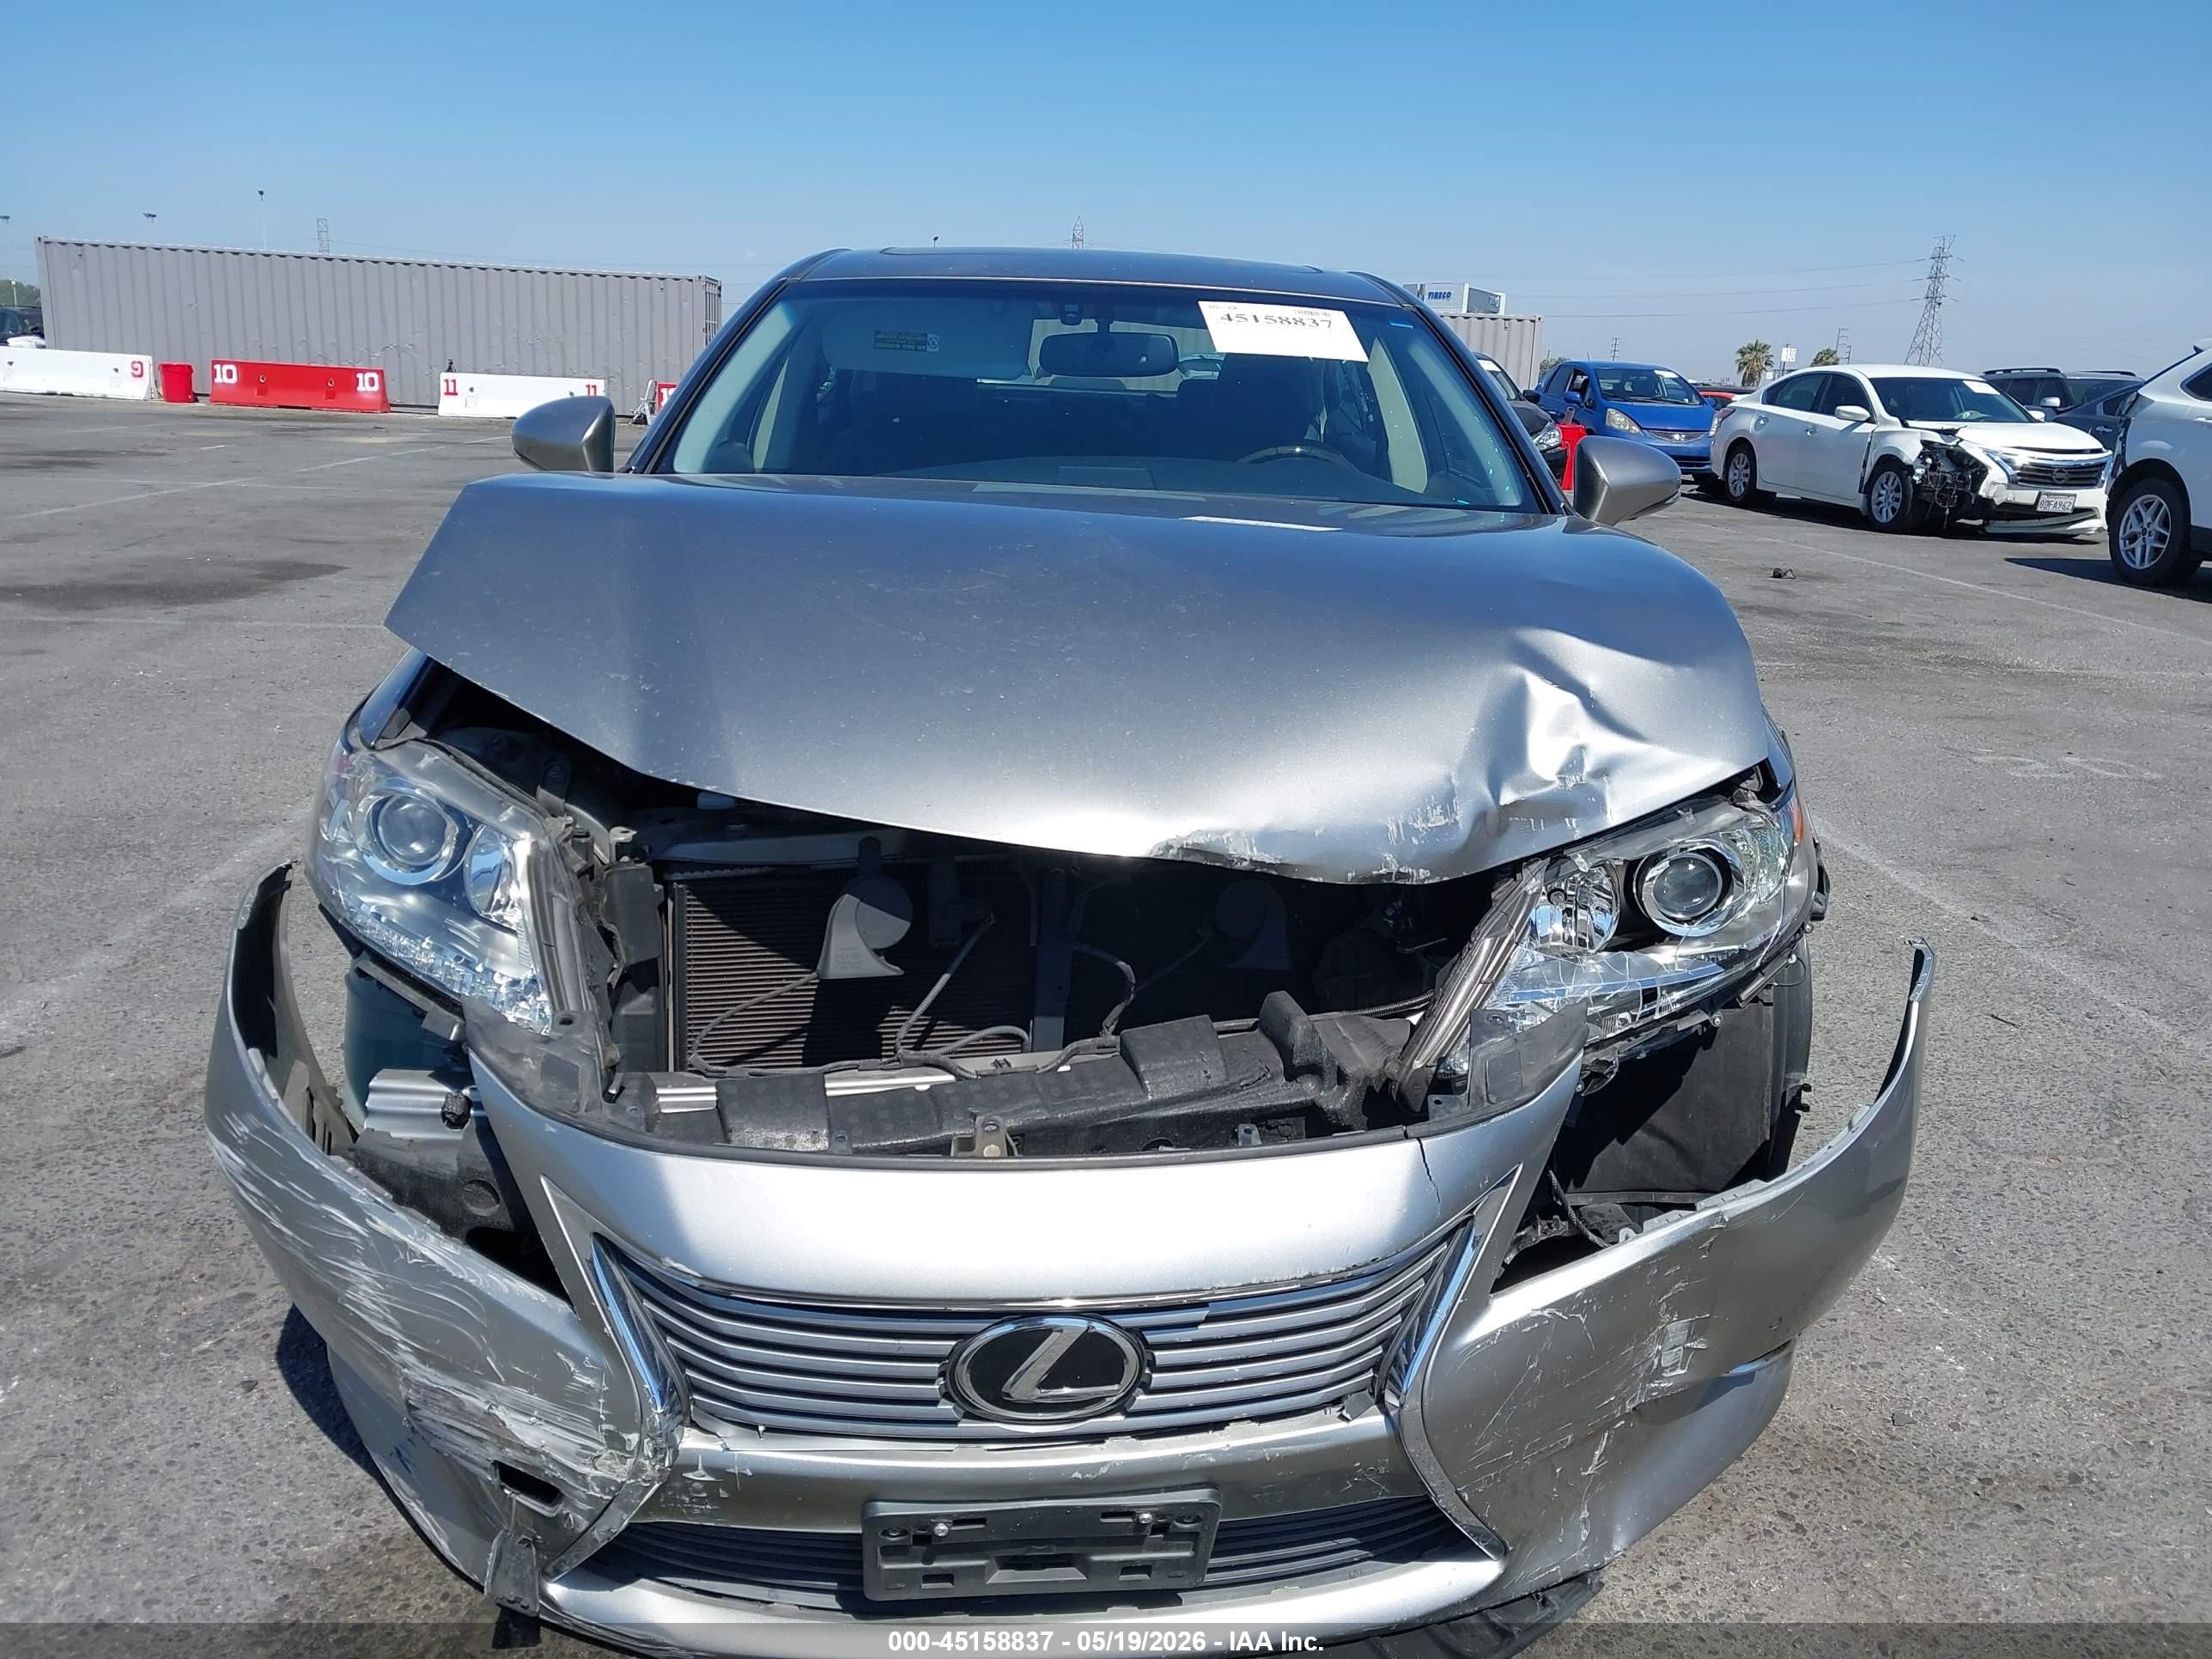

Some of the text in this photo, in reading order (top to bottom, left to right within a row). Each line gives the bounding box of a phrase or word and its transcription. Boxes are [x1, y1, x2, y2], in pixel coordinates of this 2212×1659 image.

[1220, 313, 1332, 329] 45158837
[131, 361, 144, 378] 9
[213, 364, 237, 384] 10
[356, 372, 379, 392] 10
[444, 379, 459, 396] 11
